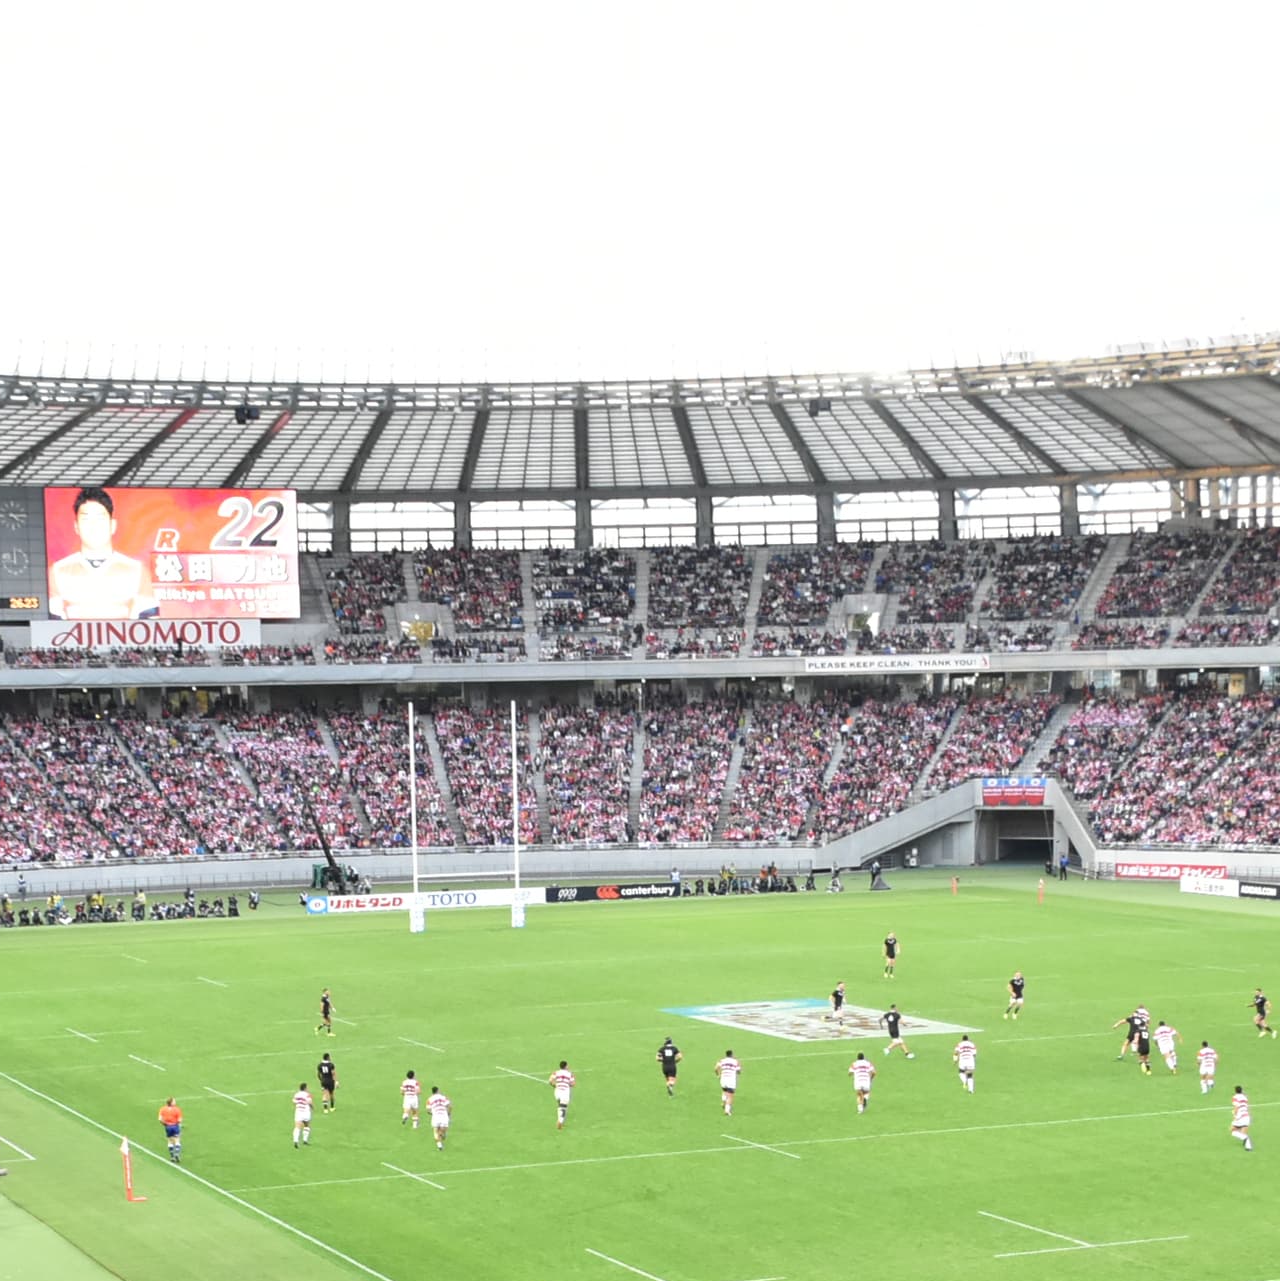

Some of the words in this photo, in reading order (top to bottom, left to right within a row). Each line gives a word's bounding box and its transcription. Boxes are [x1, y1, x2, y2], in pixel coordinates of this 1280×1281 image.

[211, 497, 285, 550] 22
[155, 529, 180, 551] R
[52, 621, 241, 648] AJINOMOTO
[428, 892, 477, 906] TOTO
[621, 884, 675, 896] canterbury
[330, 896, 403, 909] リポビタンD
